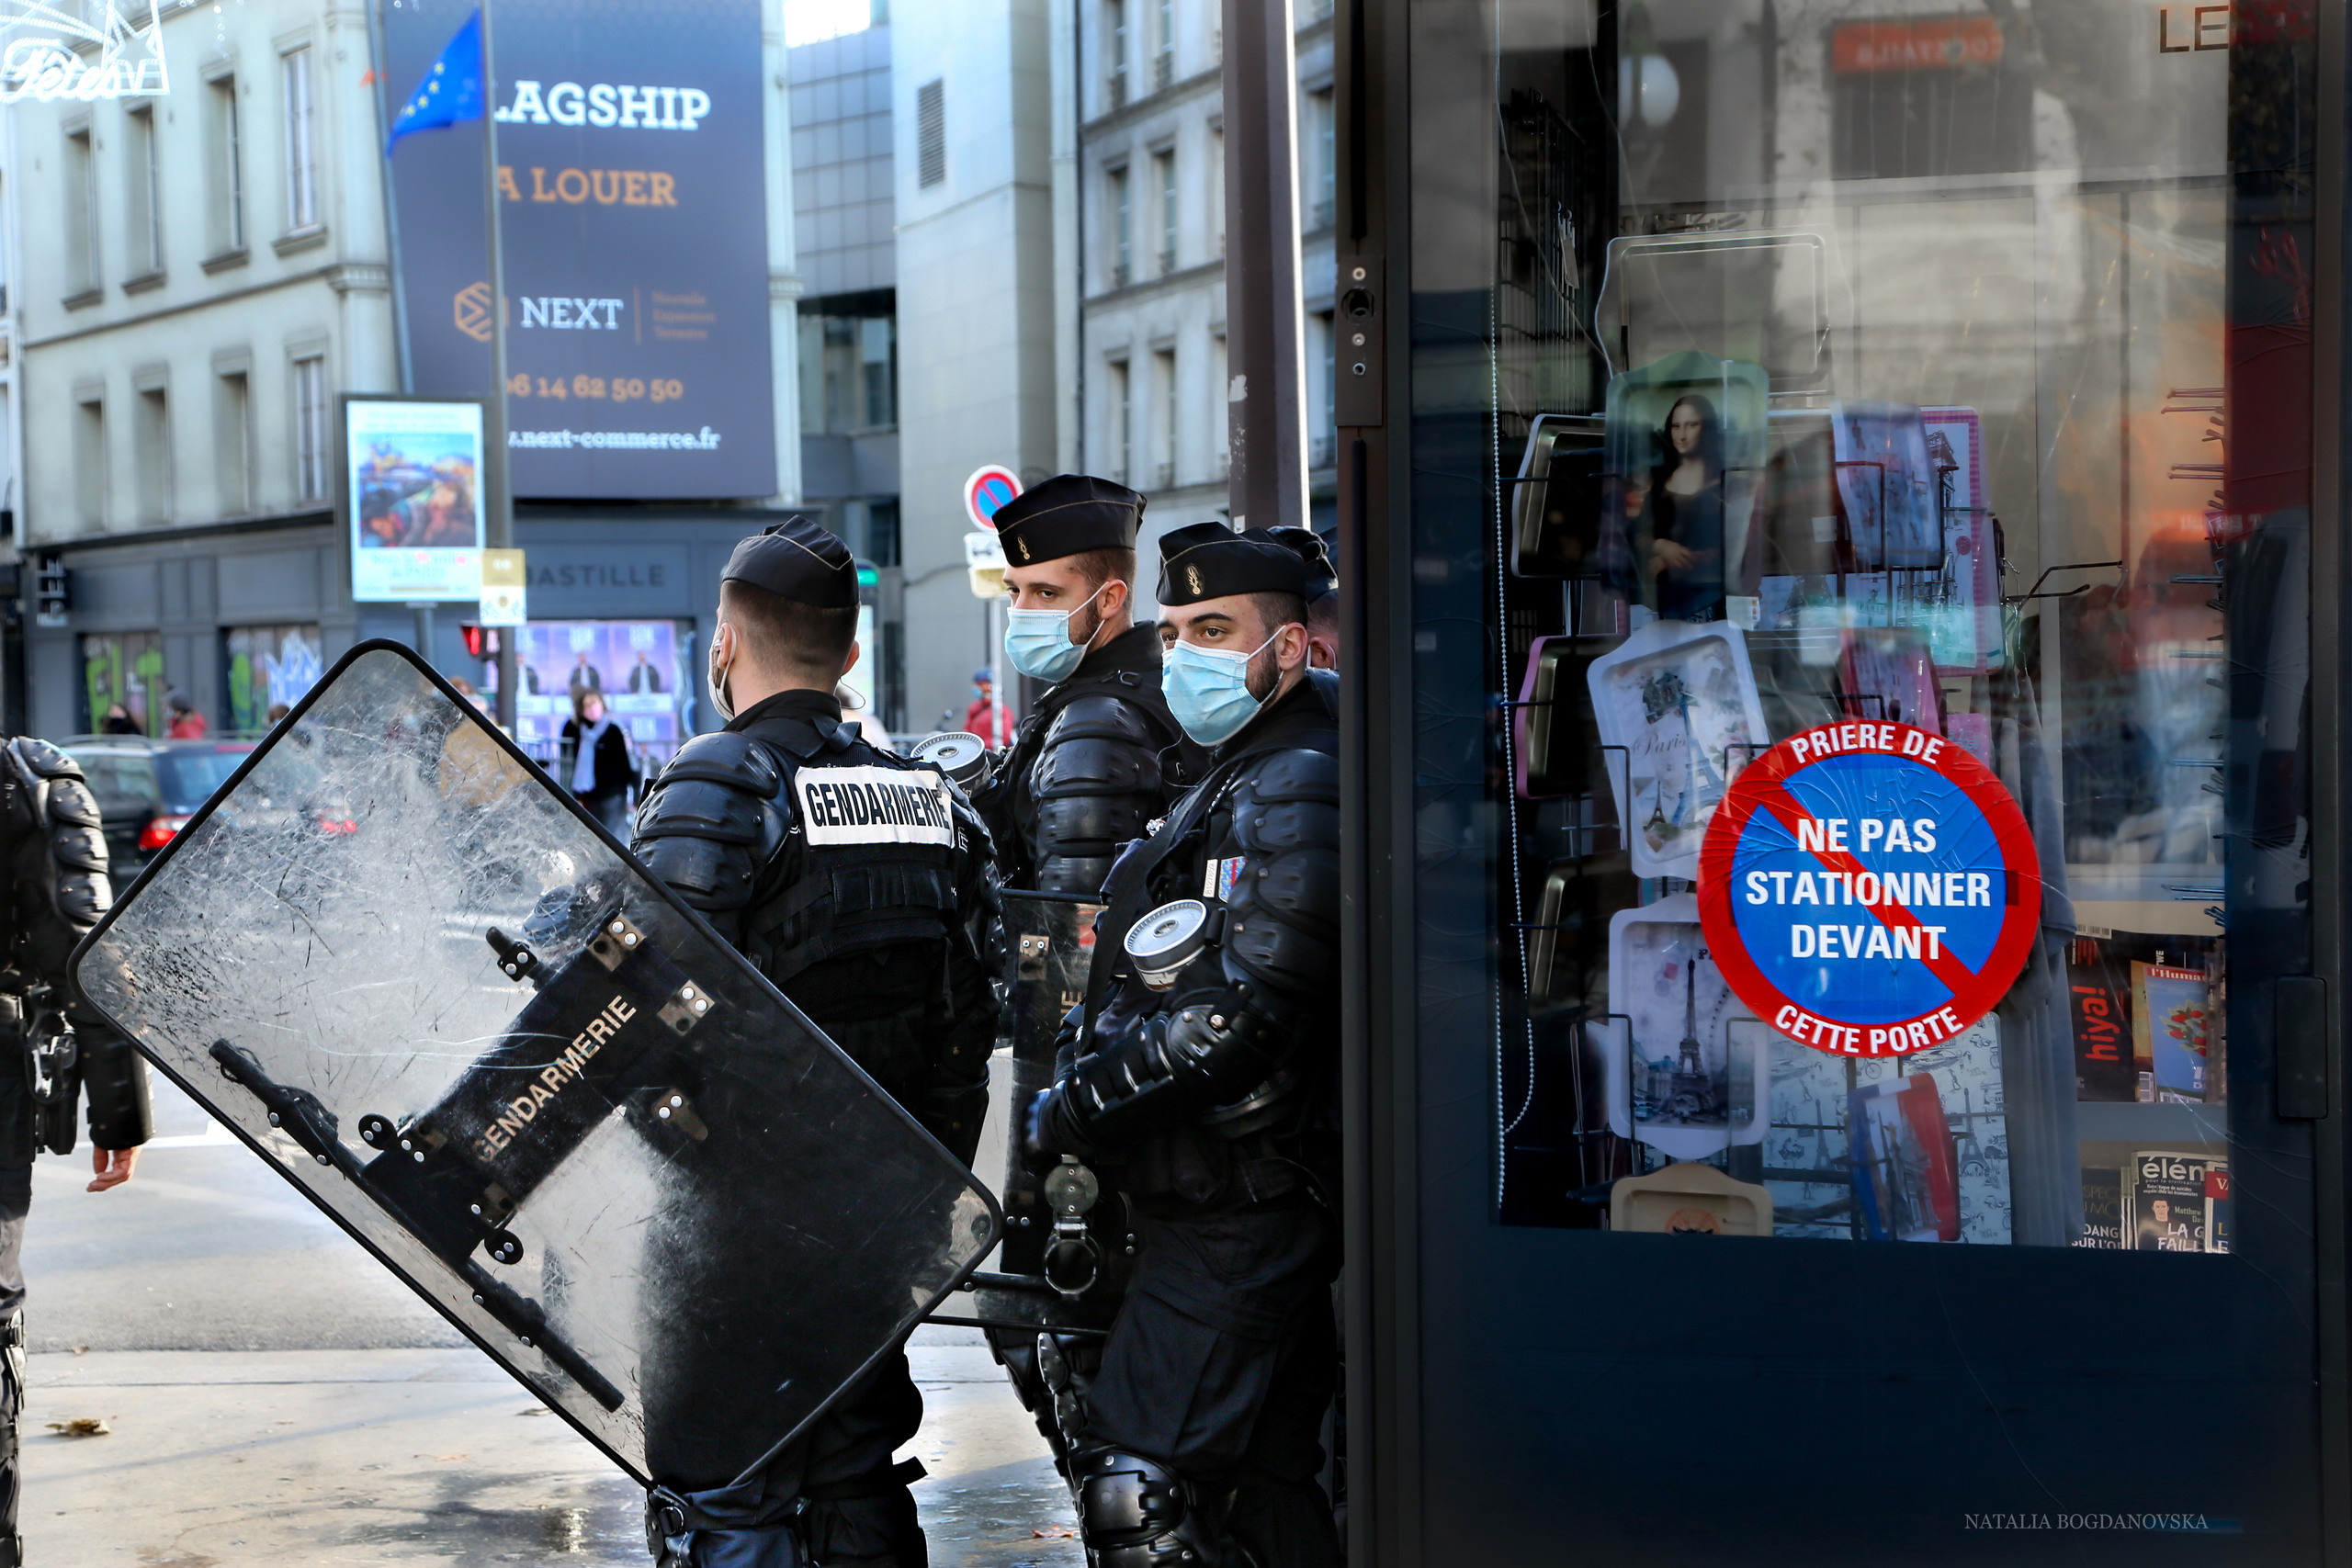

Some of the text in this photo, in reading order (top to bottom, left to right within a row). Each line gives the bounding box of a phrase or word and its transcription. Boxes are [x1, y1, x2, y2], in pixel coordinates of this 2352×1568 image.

[494, 80, 710, 130] AGSHIP
[531, 166, 678, 207] LOUER
[520, 297, 624, 330] NEXT
[537, 378, 567, 400] 14
[573, 374, 606, 398] 62
[612, 378, 645, 402] 50
[650, 378, 684, 402] 50
[1790, 723, 1944, 764] PRIERE DE
[806, 782, 950, 830] GENDARMERIE
[1797, 818, 1937, 852] NE PAS
[1746, 871, 1991, 907] STATIONNER
[1792, 924, 1946, 960] DEVANT
[2151, 967, 2205, 982] l'Huma
[1775, 1004, 1964, 1054] CETTE PORTE
[2072, 985, 2121, 1061] hiya!
[471, 995, 636, 1162] GENDARMERIE
[2175, 1205, 2202, 1215] Matthew
[2168, 1223, 2188, 1239] LA
